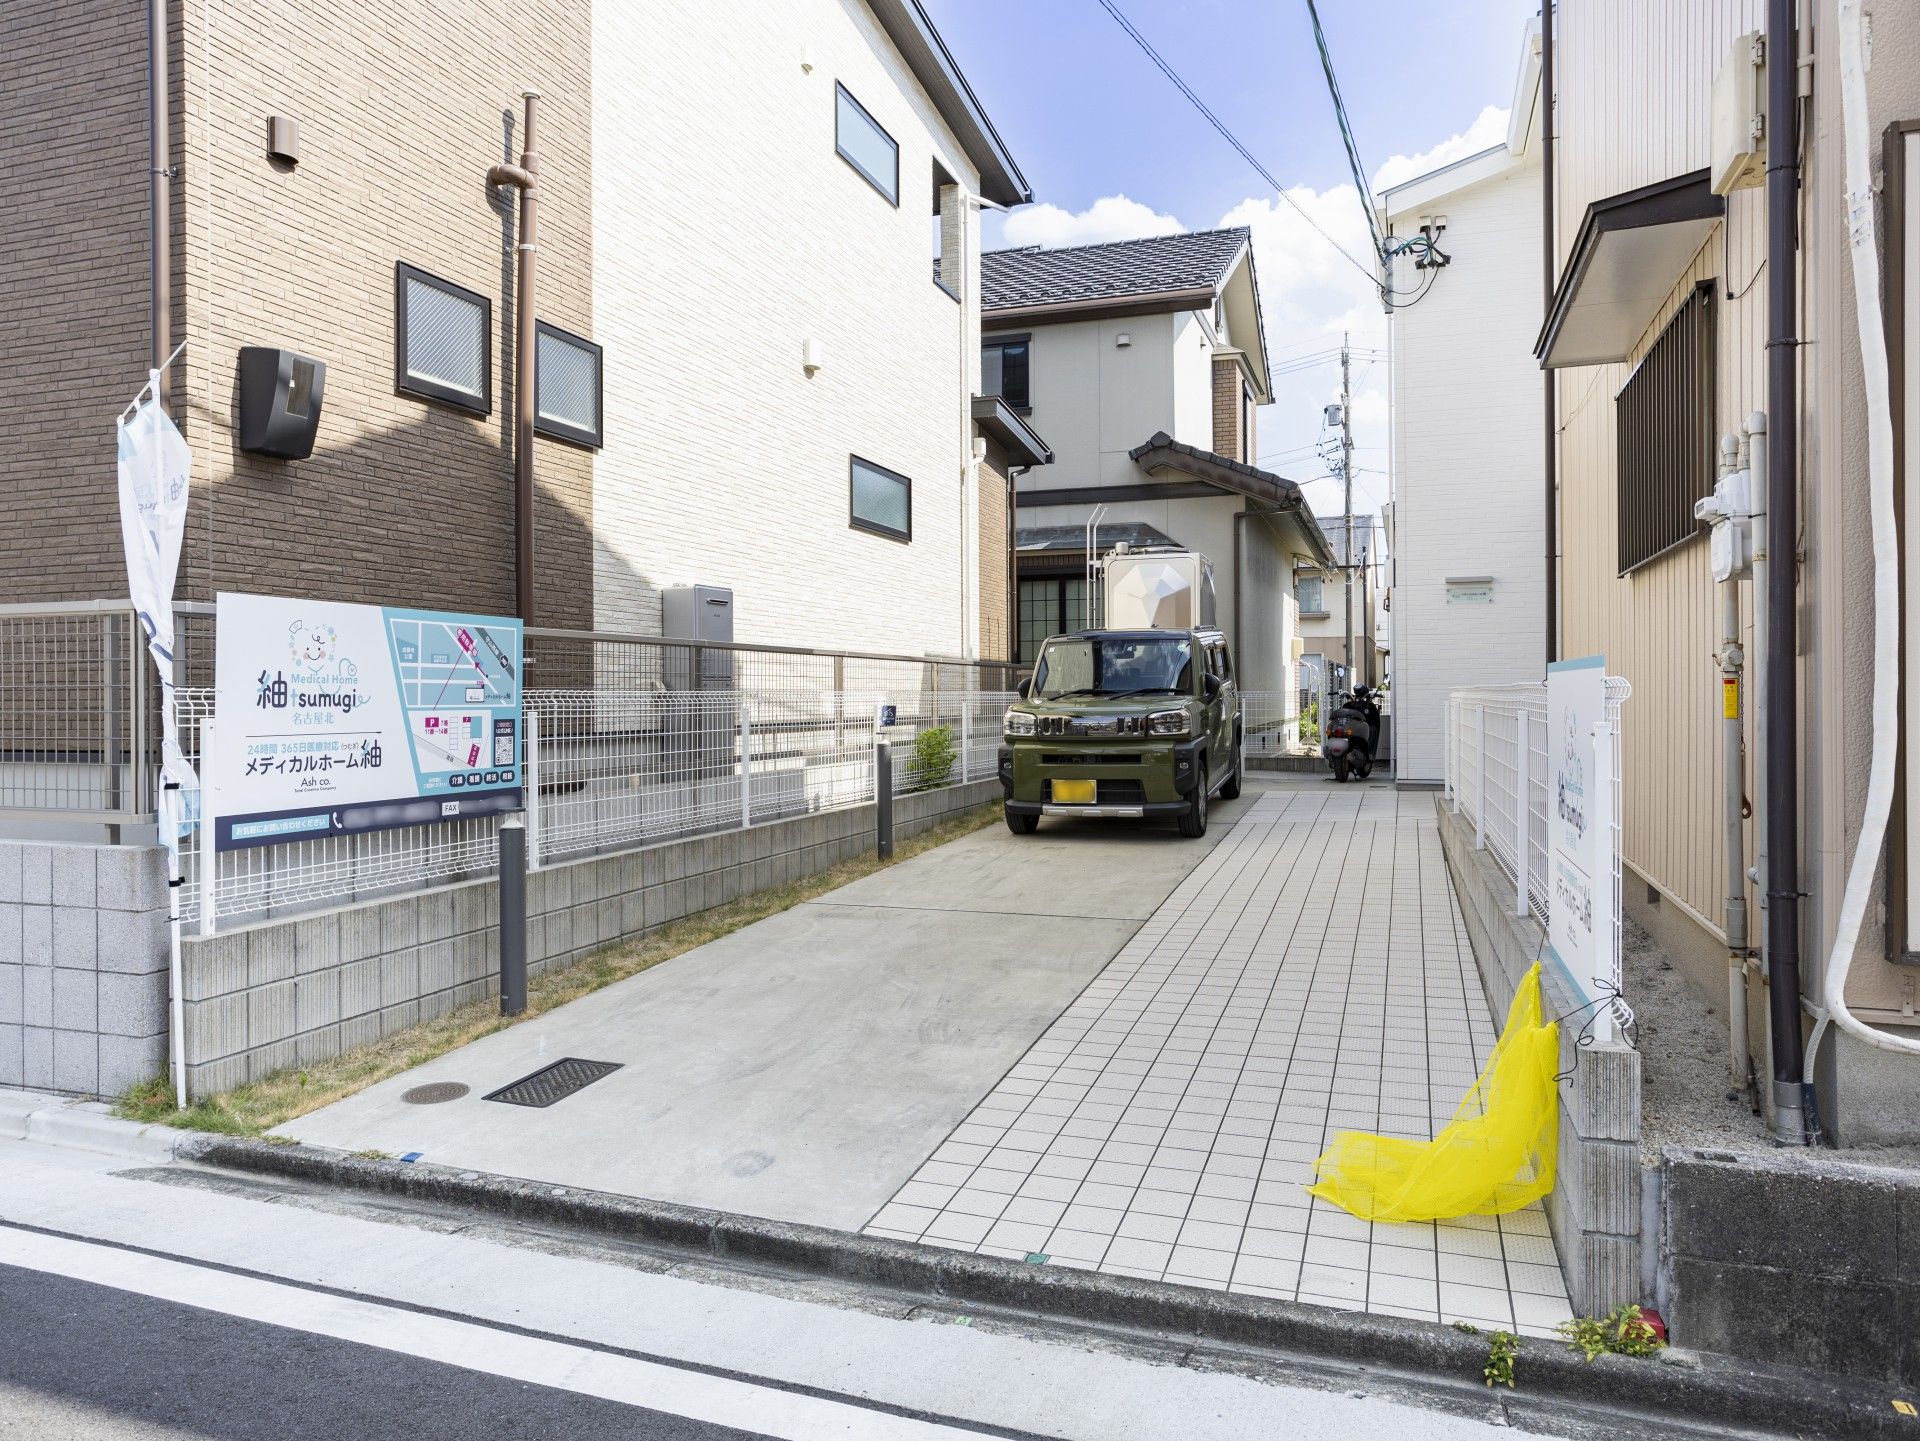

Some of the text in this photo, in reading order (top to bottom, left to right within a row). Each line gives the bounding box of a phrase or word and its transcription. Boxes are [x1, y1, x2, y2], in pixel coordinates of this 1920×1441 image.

[291, 674, 358, 684] Medical Home
[290, 688, 356, 714] tsumugi
[292, 712, 334, 725] 名古屋北
[248, 744, 278, 756] 24時間
[280, 742, 340, 754] 365日医療対応
[246, 739, 382, 776] メディカルホーム紬
[300, 776, 317, 787] Ash
